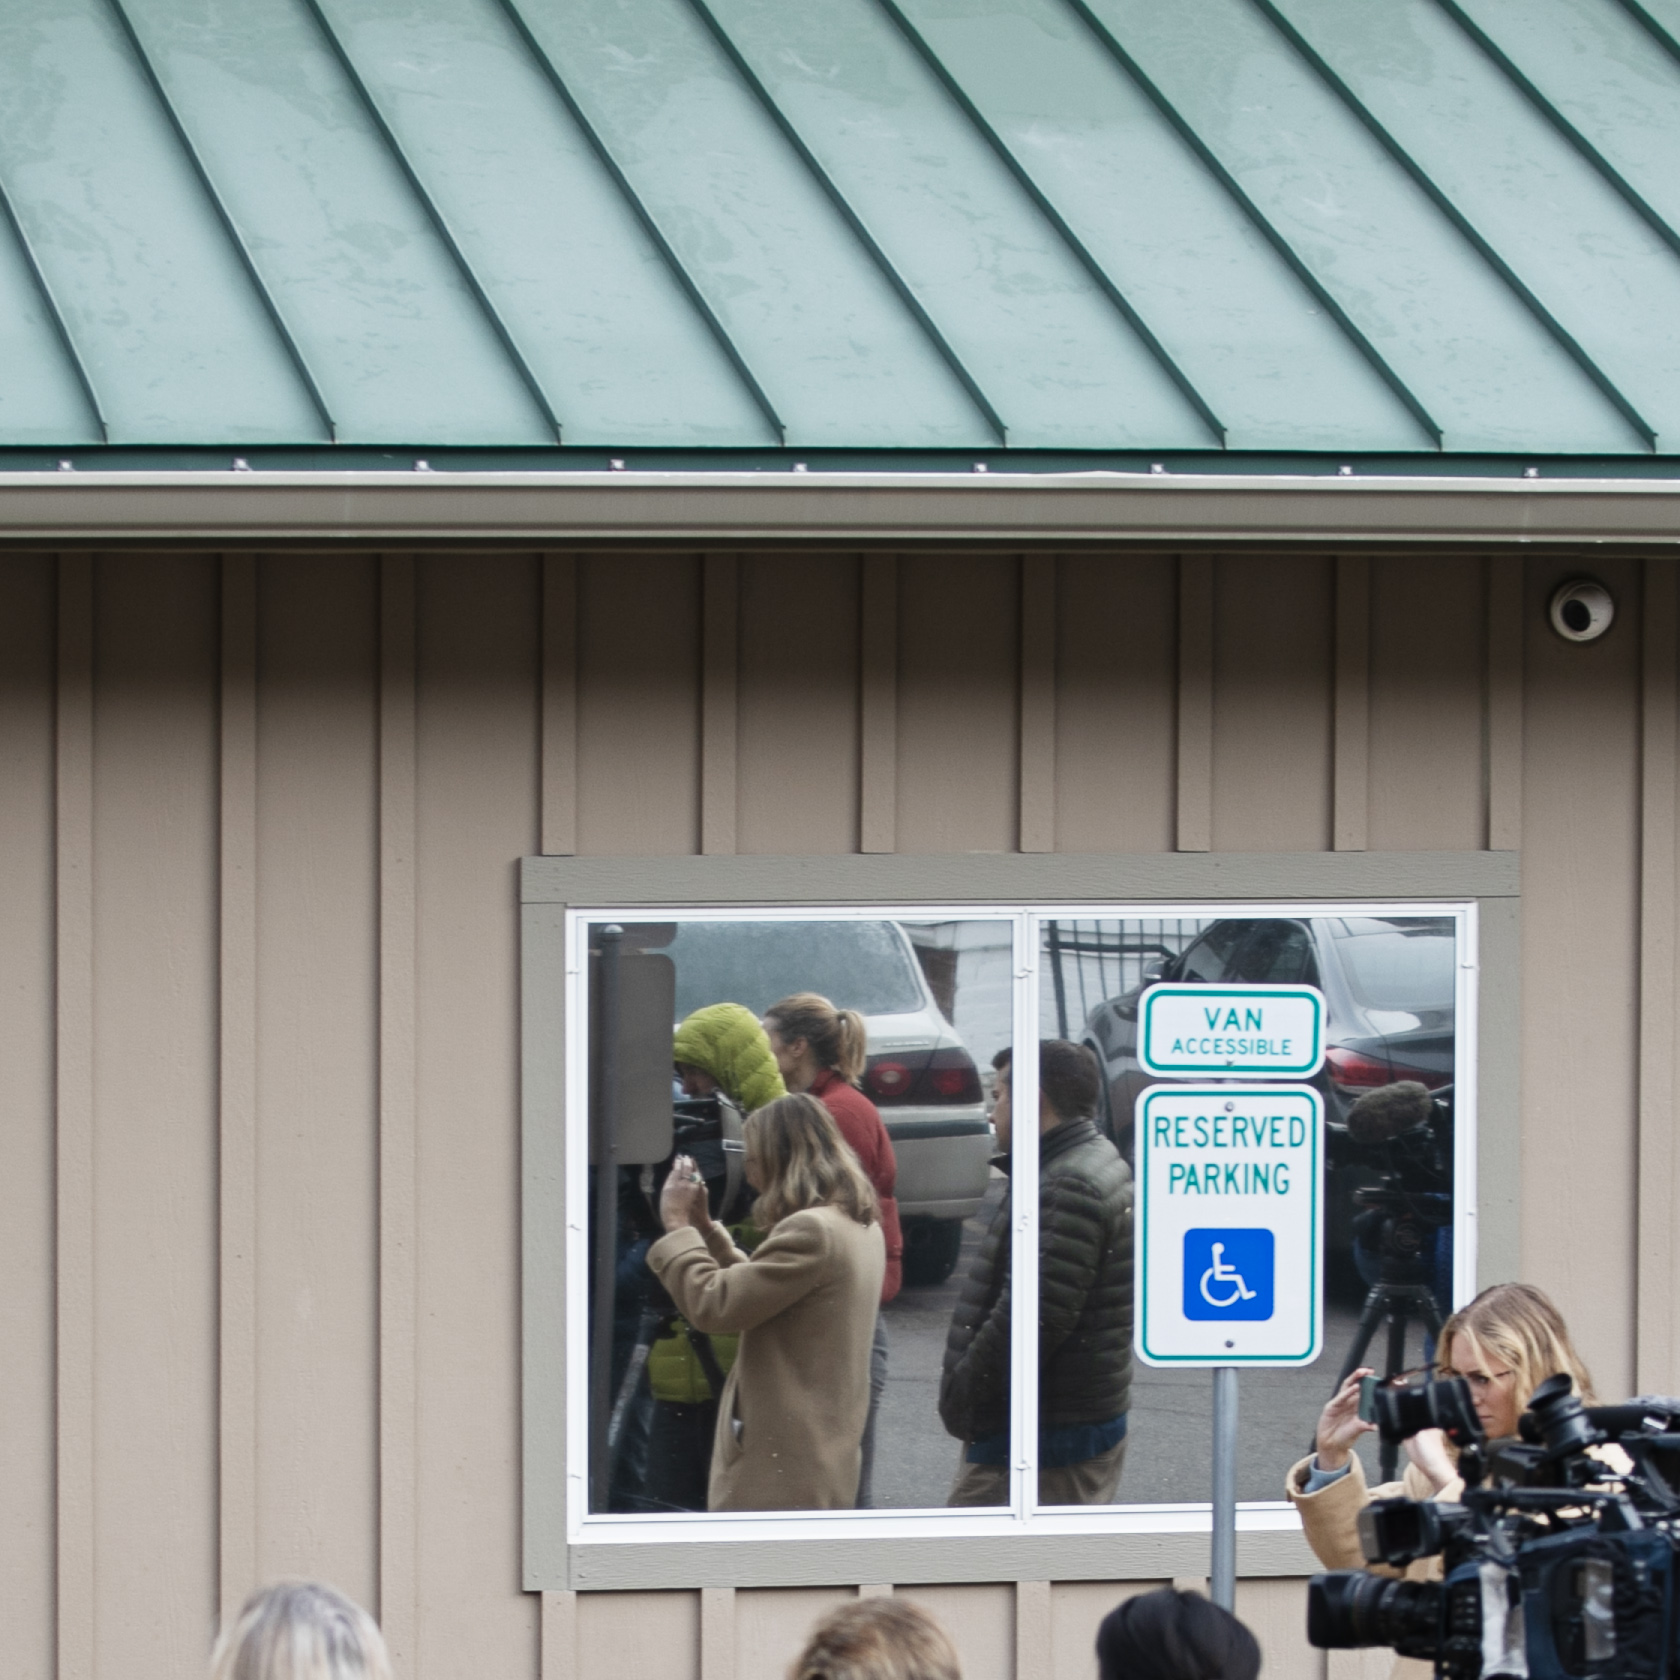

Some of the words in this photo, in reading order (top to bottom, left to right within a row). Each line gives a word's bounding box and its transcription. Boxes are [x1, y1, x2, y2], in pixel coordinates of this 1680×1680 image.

[1204, 1008, 1263, 1032] VAN
[1171, 1037, 1292, 1056] ACCESSIBLE
[1154, 1115, 1306, 1148] RESERVED
[1169, 1162, 1290, 1195] PARKING
